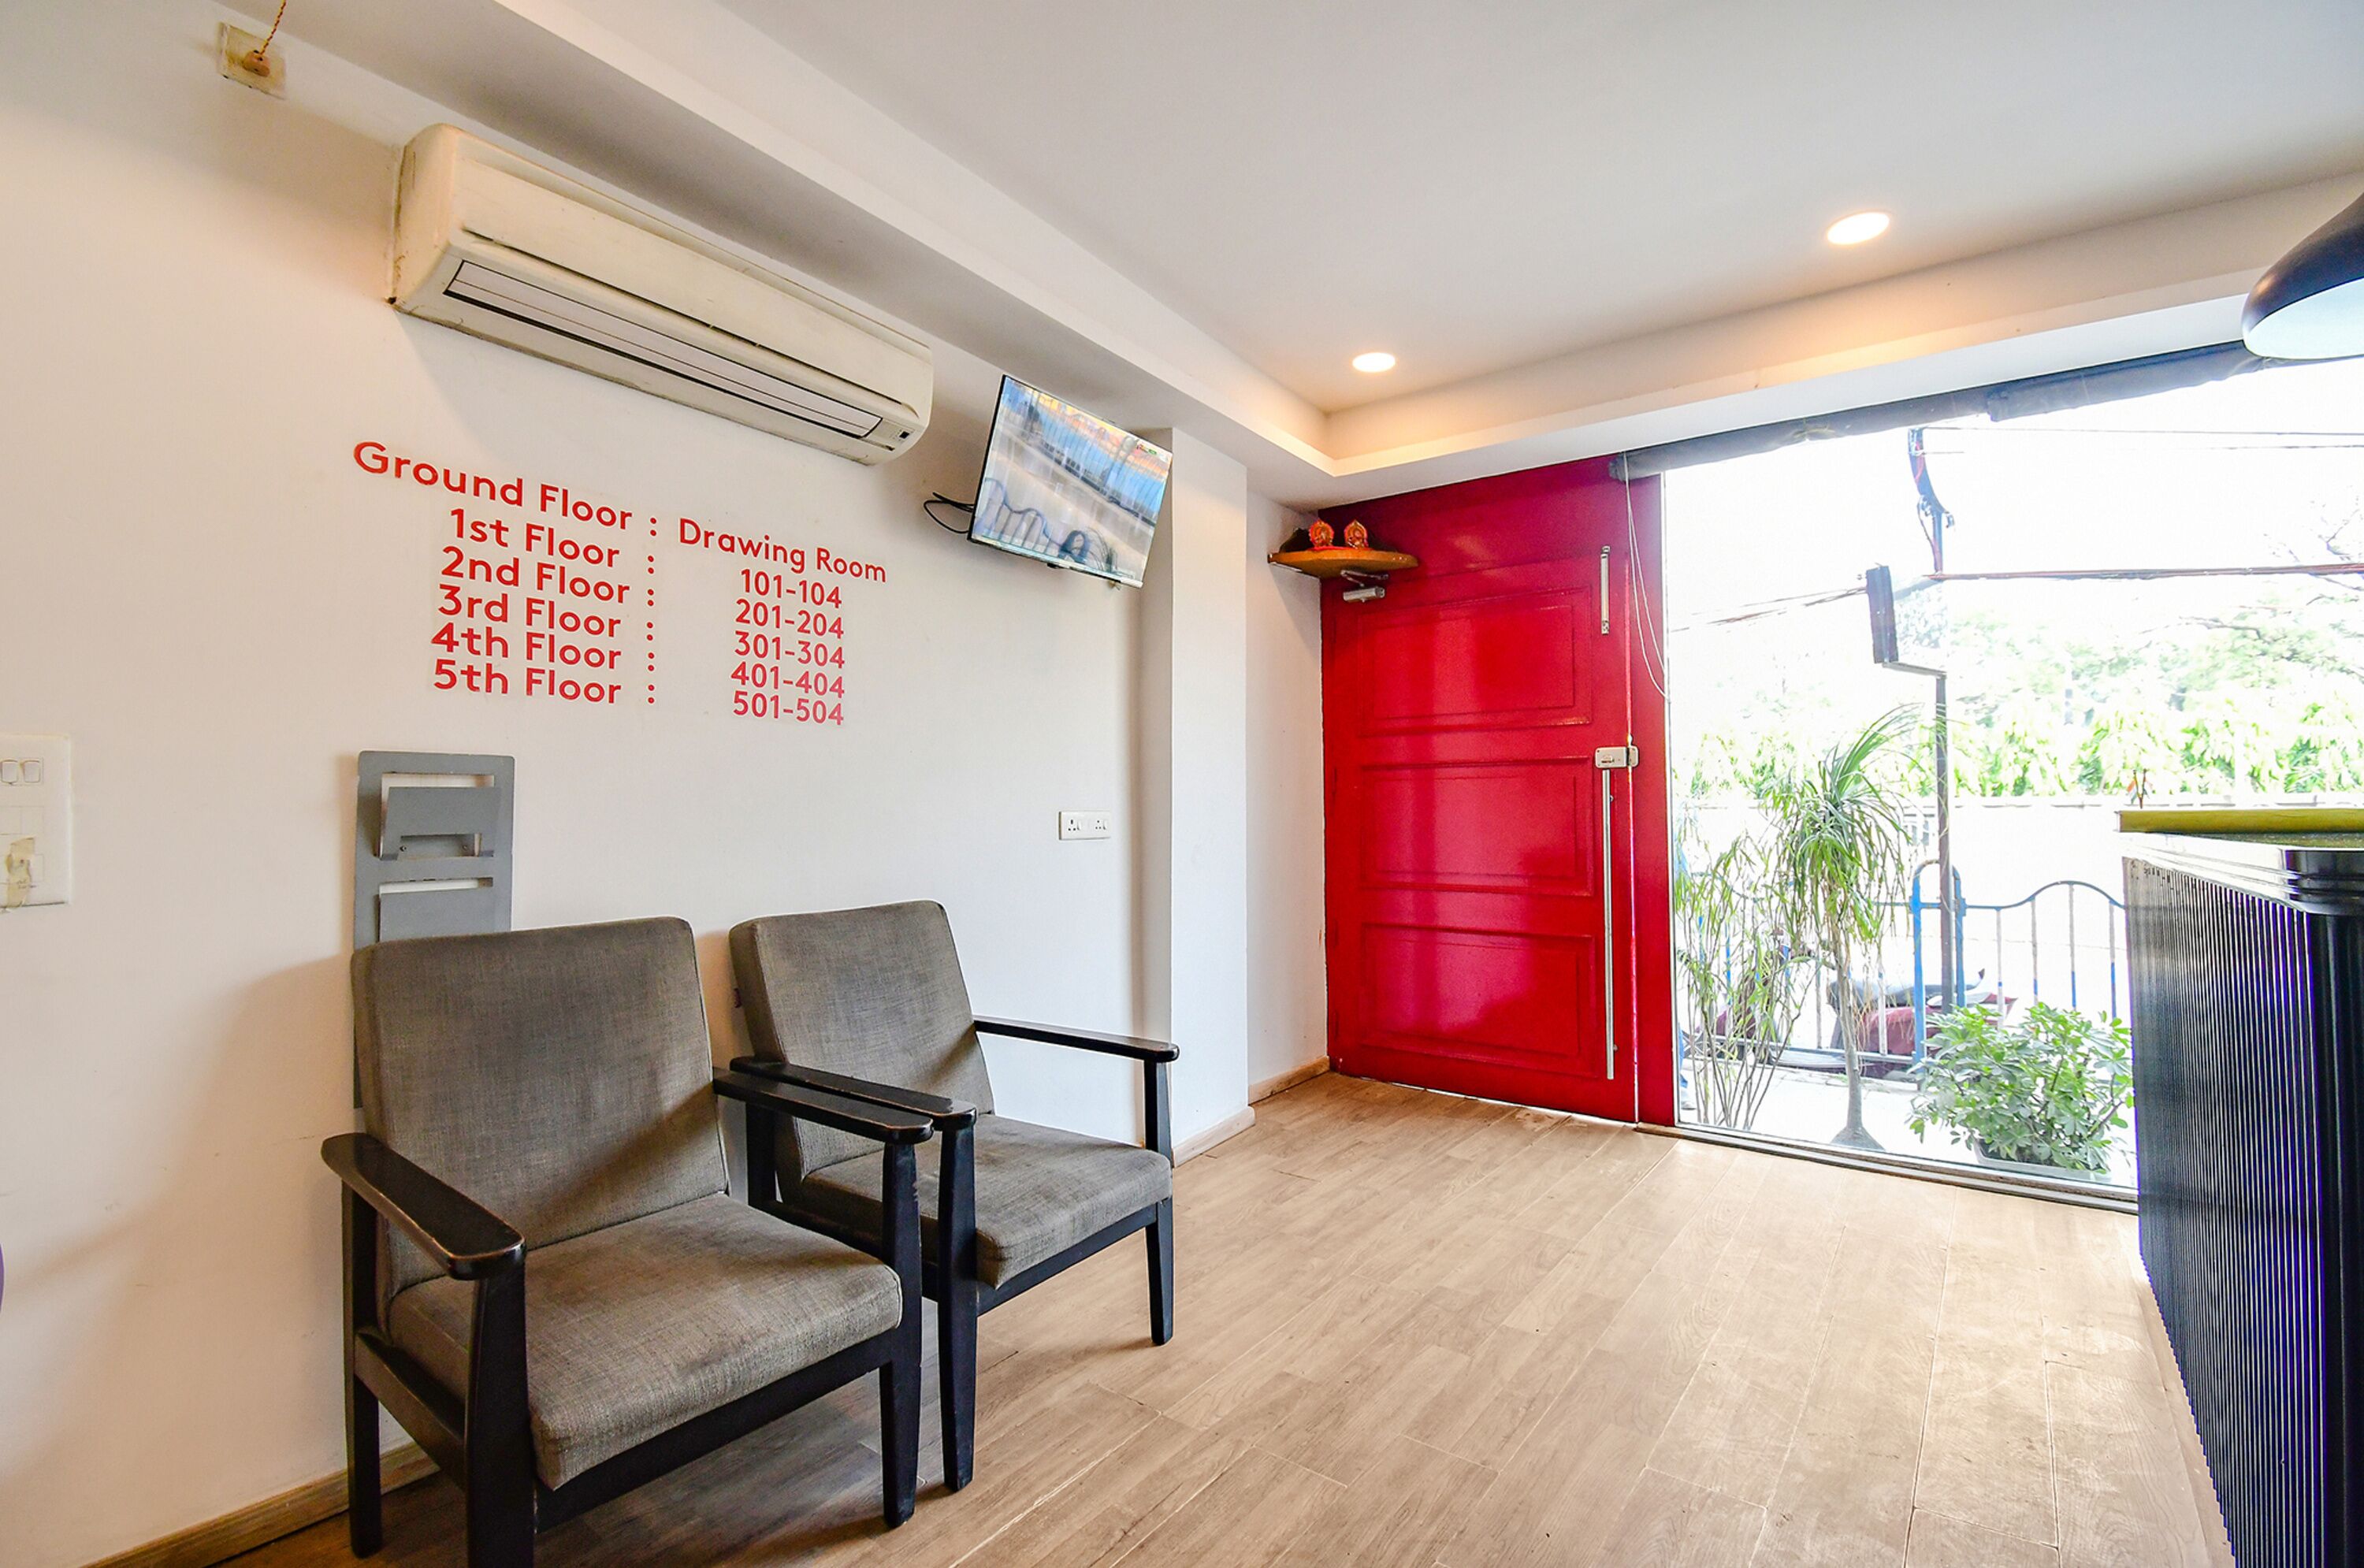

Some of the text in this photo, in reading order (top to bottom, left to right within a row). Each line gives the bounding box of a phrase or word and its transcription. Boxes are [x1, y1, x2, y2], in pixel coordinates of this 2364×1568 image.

[352, 440, 524, 507] Ground
[540, 483, 634, 530] Floor
[679, 518, 805, 574] Drawing
[816, 547, 886, 583] Room
[441, 544, 520, 588] 2nd
[536, 561, 630, 604] Floor
[735, 598, 844, 640] 201-204
[450, 507, 510, 548] 1st
[525, 522, 620, 568] Floor
[741, 568, 842, 609] 101-104
[430, 621, 509, 659] 4th
[526, 630, 623, 670] Floor
[730, 660, 845, 699] 401-404
[437, 583, 509, 624] 3rd
[525, 596, 622, 638] Floor
[734, 630, 846, 669] 301-304
[433, 657, 509, 694] 5th
[526, 667, 623, 704] Floor
[733, 689, 843, 726] 501-504
